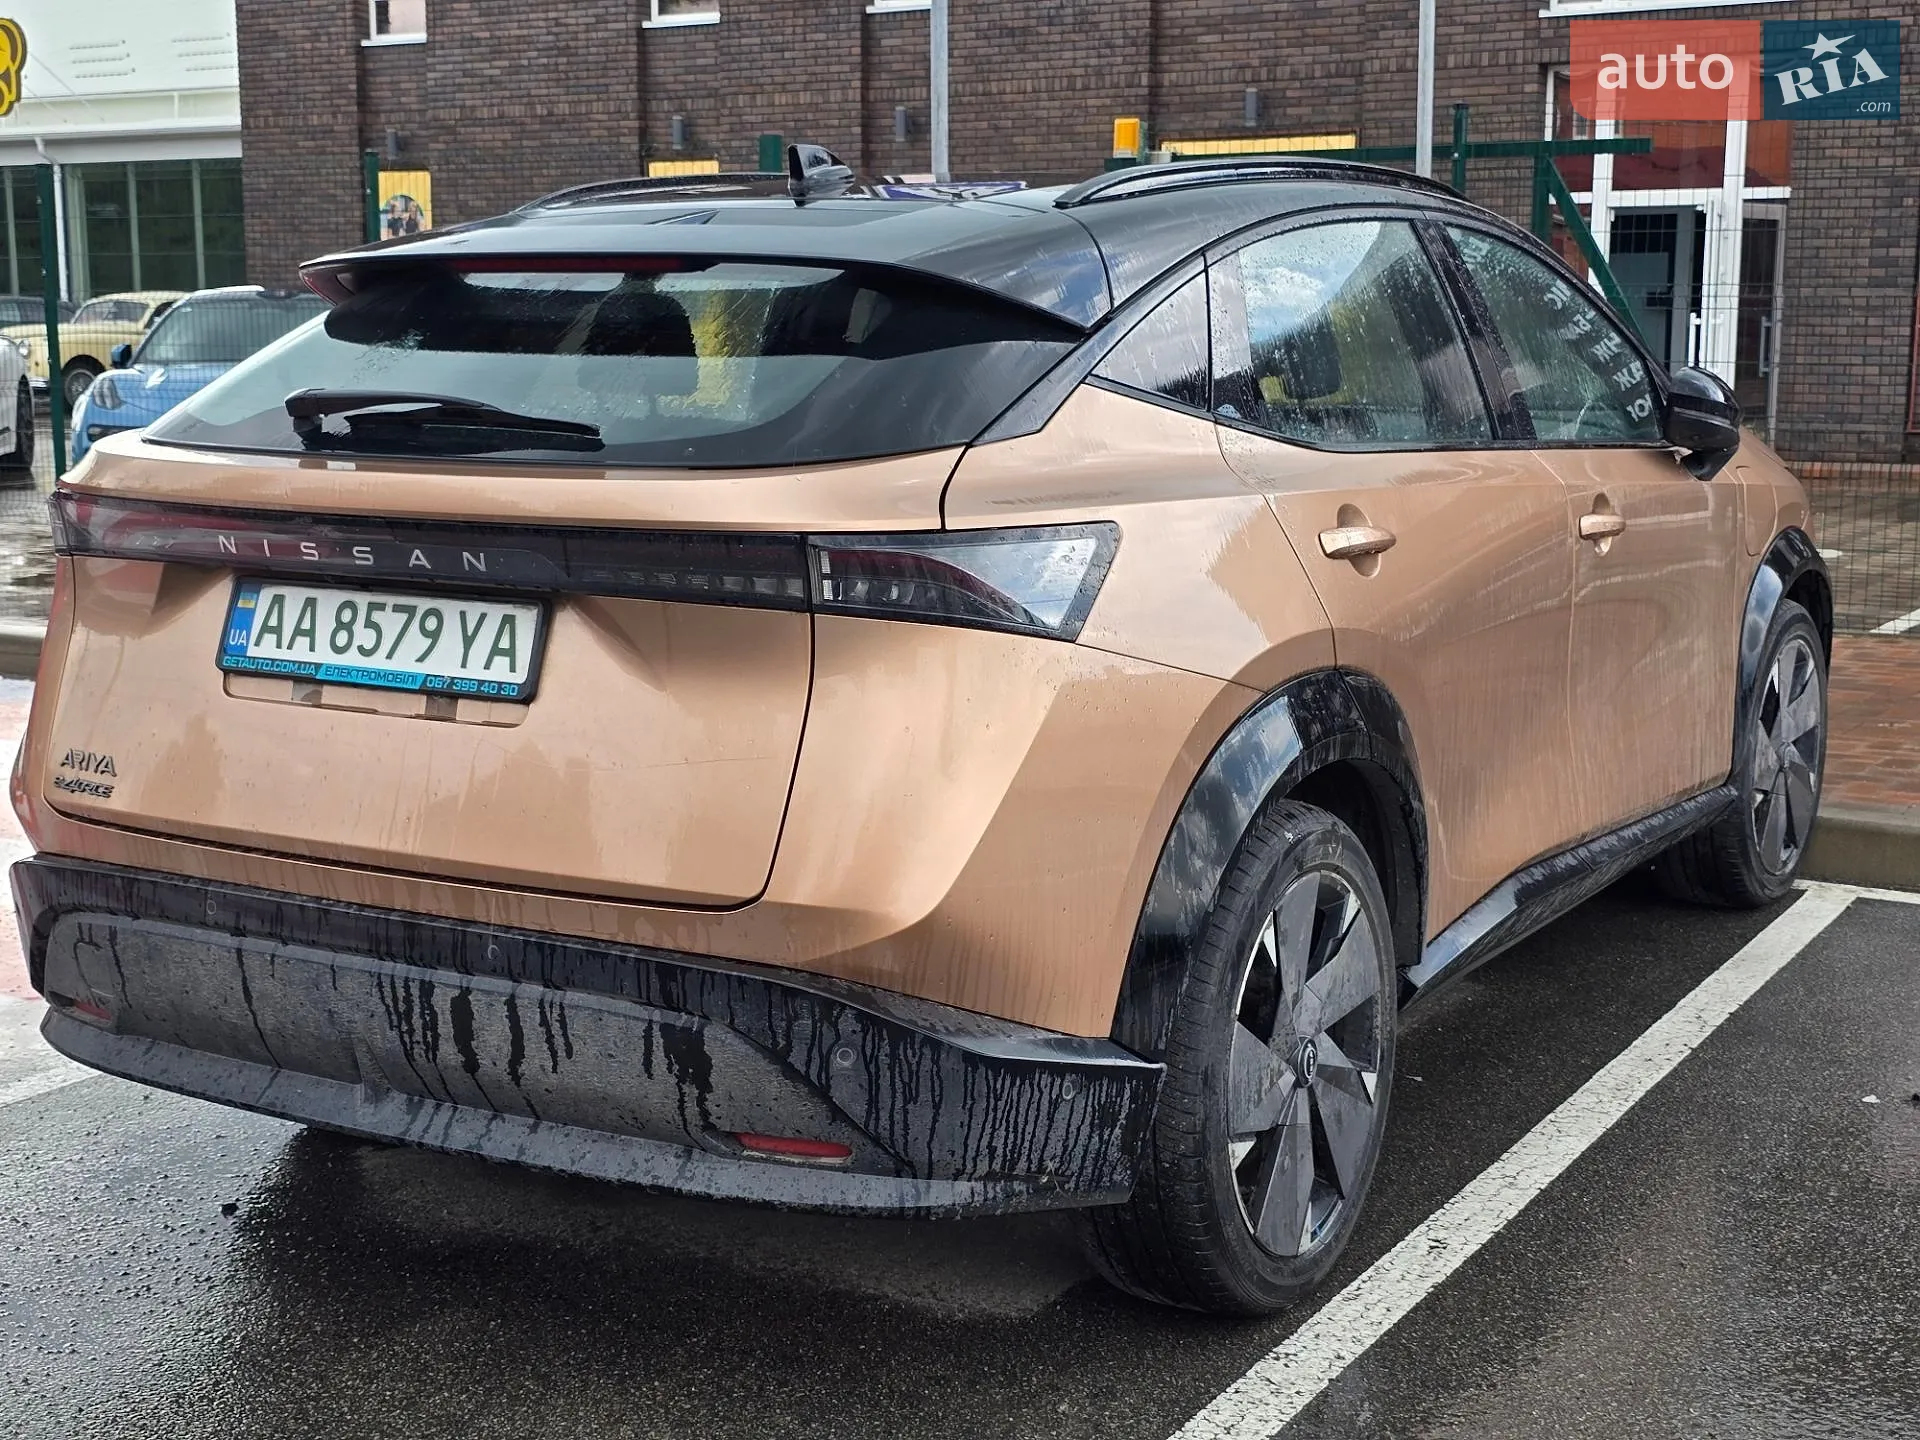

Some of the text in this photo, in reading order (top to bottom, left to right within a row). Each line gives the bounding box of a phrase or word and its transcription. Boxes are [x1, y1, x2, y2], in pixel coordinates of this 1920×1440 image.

[218, 535, 488, 572] NISSAN
[229, 628, 247, 648] UA
[253, 593, 517, 674] AA 8579 YA
[223, 655, 316, 676] GETAUTO.COM.UA
[426, 676, 519, 696] 067 399 40 30
[60, 748, 117, 777] ARIYA
